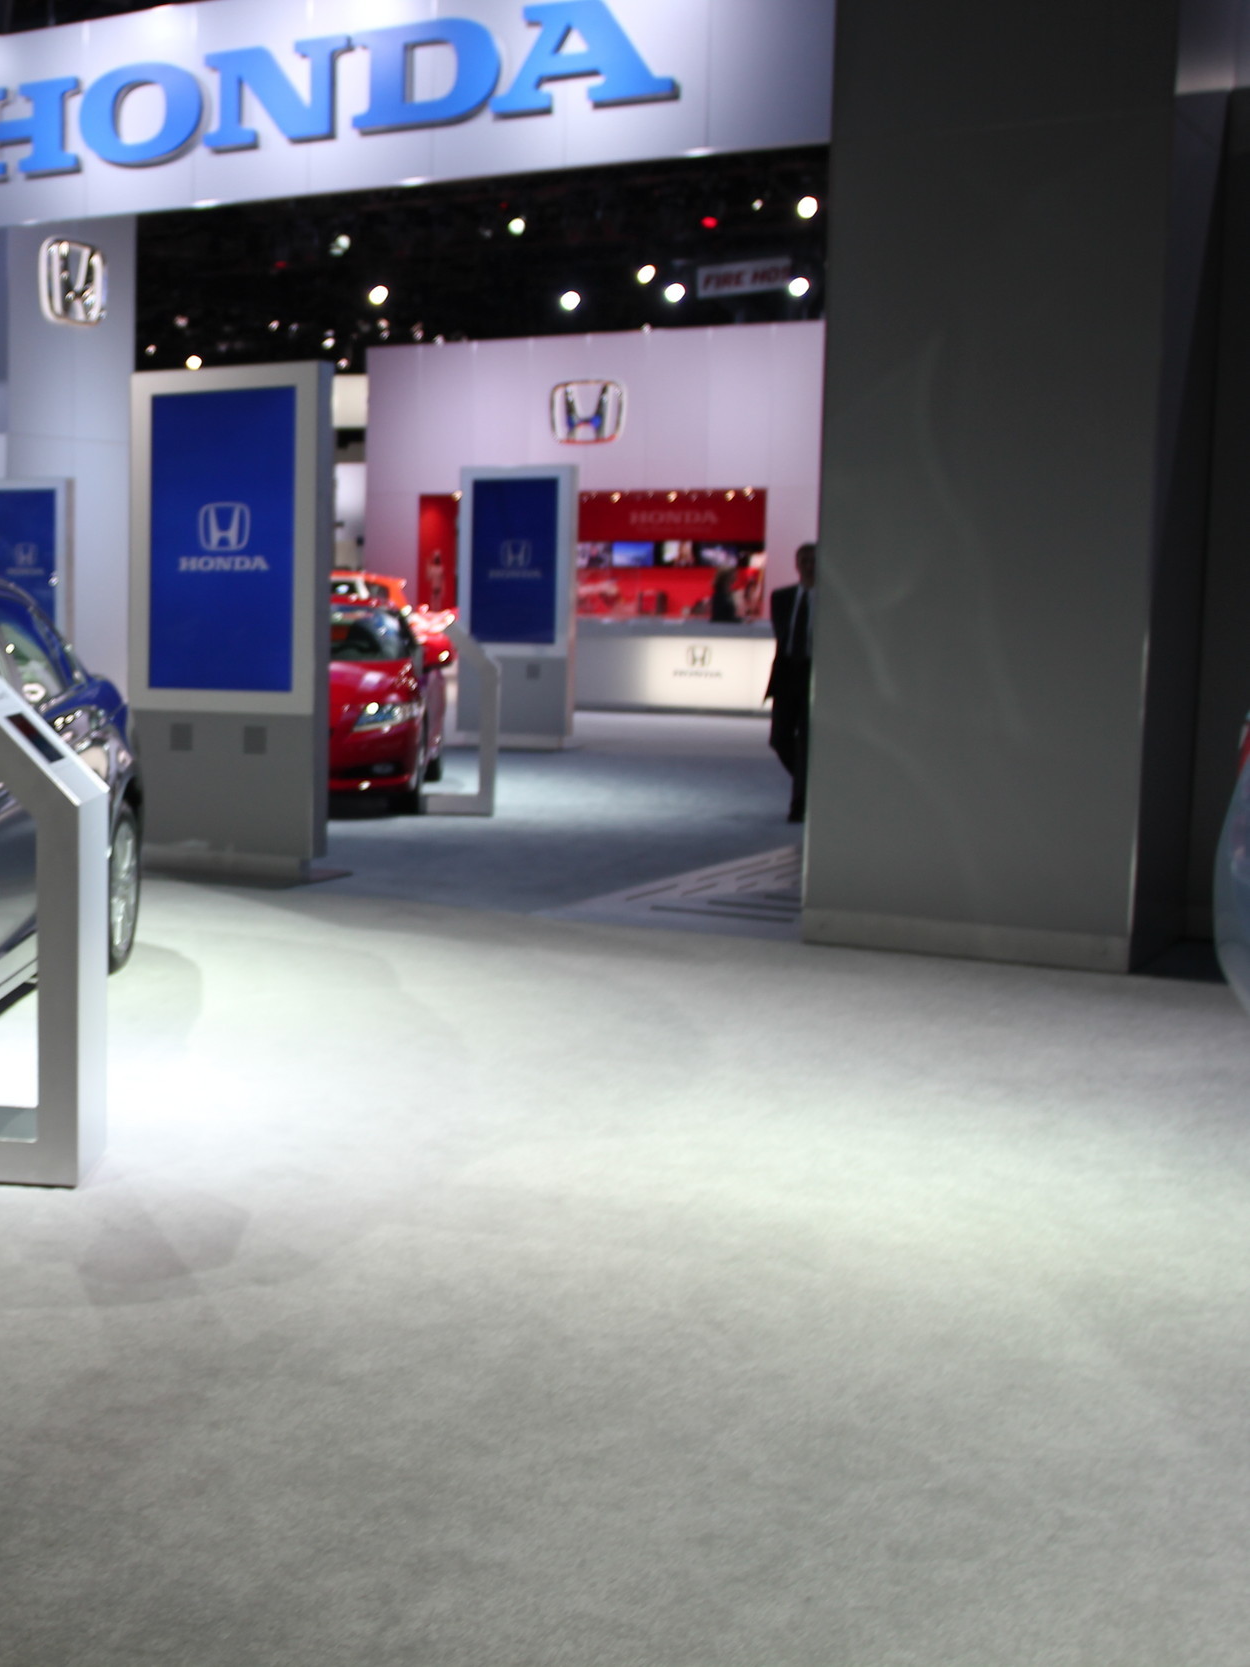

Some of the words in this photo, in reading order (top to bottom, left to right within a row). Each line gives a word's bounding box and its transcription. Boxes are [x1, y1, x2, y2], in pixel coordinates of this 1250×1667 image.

[703, 269, 746, 291] FIRE
[750, 265, 792, 284] HOS
[629, 509, 718, 525] HONDA
[178, 555, 269, 572] HONDA
